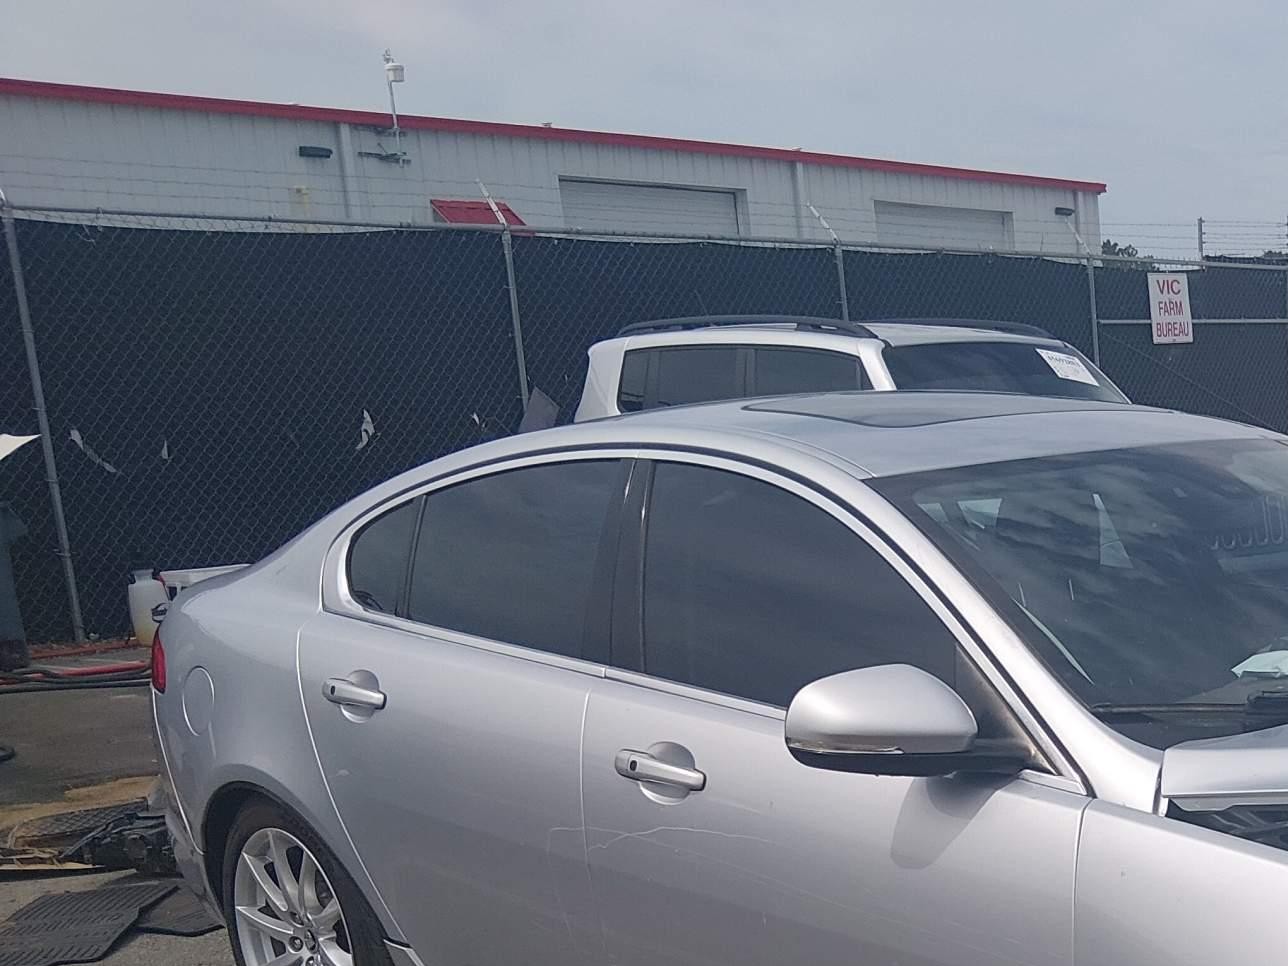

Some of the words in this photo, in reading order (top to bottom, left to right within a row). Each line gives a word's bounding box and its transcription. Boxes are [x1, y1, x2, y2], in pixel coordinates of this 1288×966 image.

[1156, 279, 1181, 295] VIC
[1158, 301, 1184, 316] FARM
[1156, 321, 1189, 337] BUREAU
